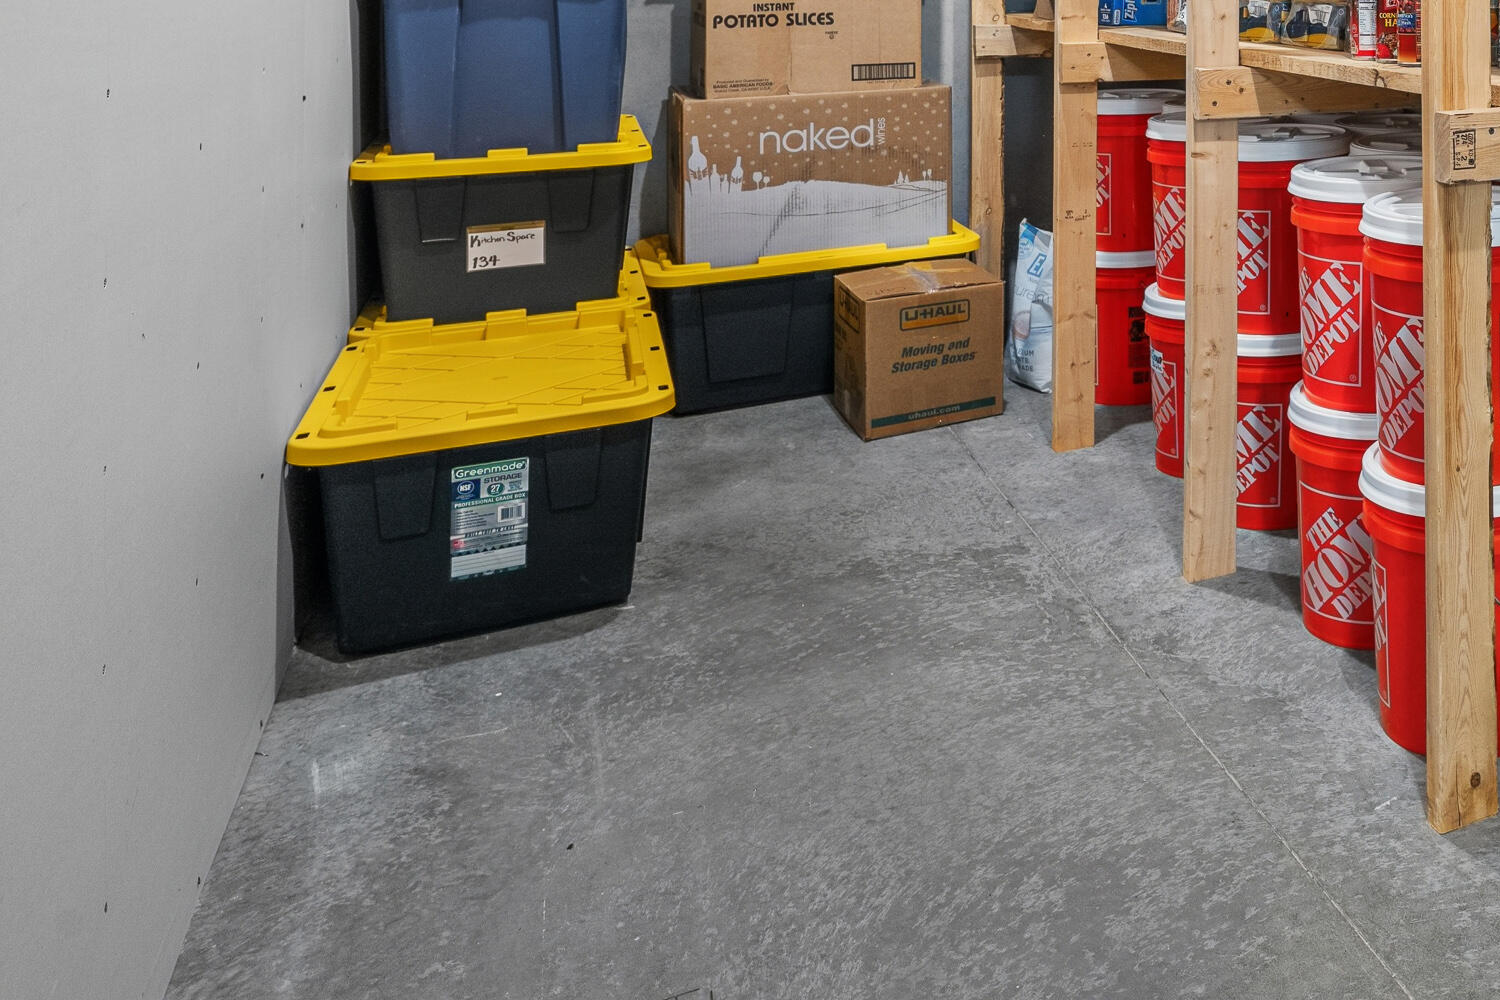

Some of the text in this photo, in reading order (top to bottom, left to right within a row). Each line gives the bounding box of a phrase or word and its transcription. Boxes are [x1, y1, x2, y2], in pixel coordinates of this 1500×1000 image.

[753, 2, 795, 12] INSTANT
[1379, 12, 1399, 20] CORN
[713, 12, 835, 29] POTATO SLICES
[759, 118, 875, 155] naked
[877, 117, 887, 144] wines
[1154, 188, 1185, 247] OME
[469, 233, 506, 248] Kitchen
[472, 255, 498, 269] 134
[1237, 249, 1268, 296] POT
[904, 303, 966, 321] U-HAUL
[1301, 262, 1361, 345] OME
[901, 338, 970, 359] Moving and
[1306, 308, 1361, 376] DEPOT
[891, 352, 975, 374] Storage Boxes
[908, 405, 961, 420] uhaul.com
[484, 472, 522, 484] STORAGE
[1236, 445, 1280, 499] EPOT
[460, 484, 500, 493] NSF 27
[454, 498, 494, 509] PROFESSIONAL
[495, 494, 513, 502] GRADE
[1305, 507, 1344, 551] THE
[1303, 516, 1372, 612] HOM
